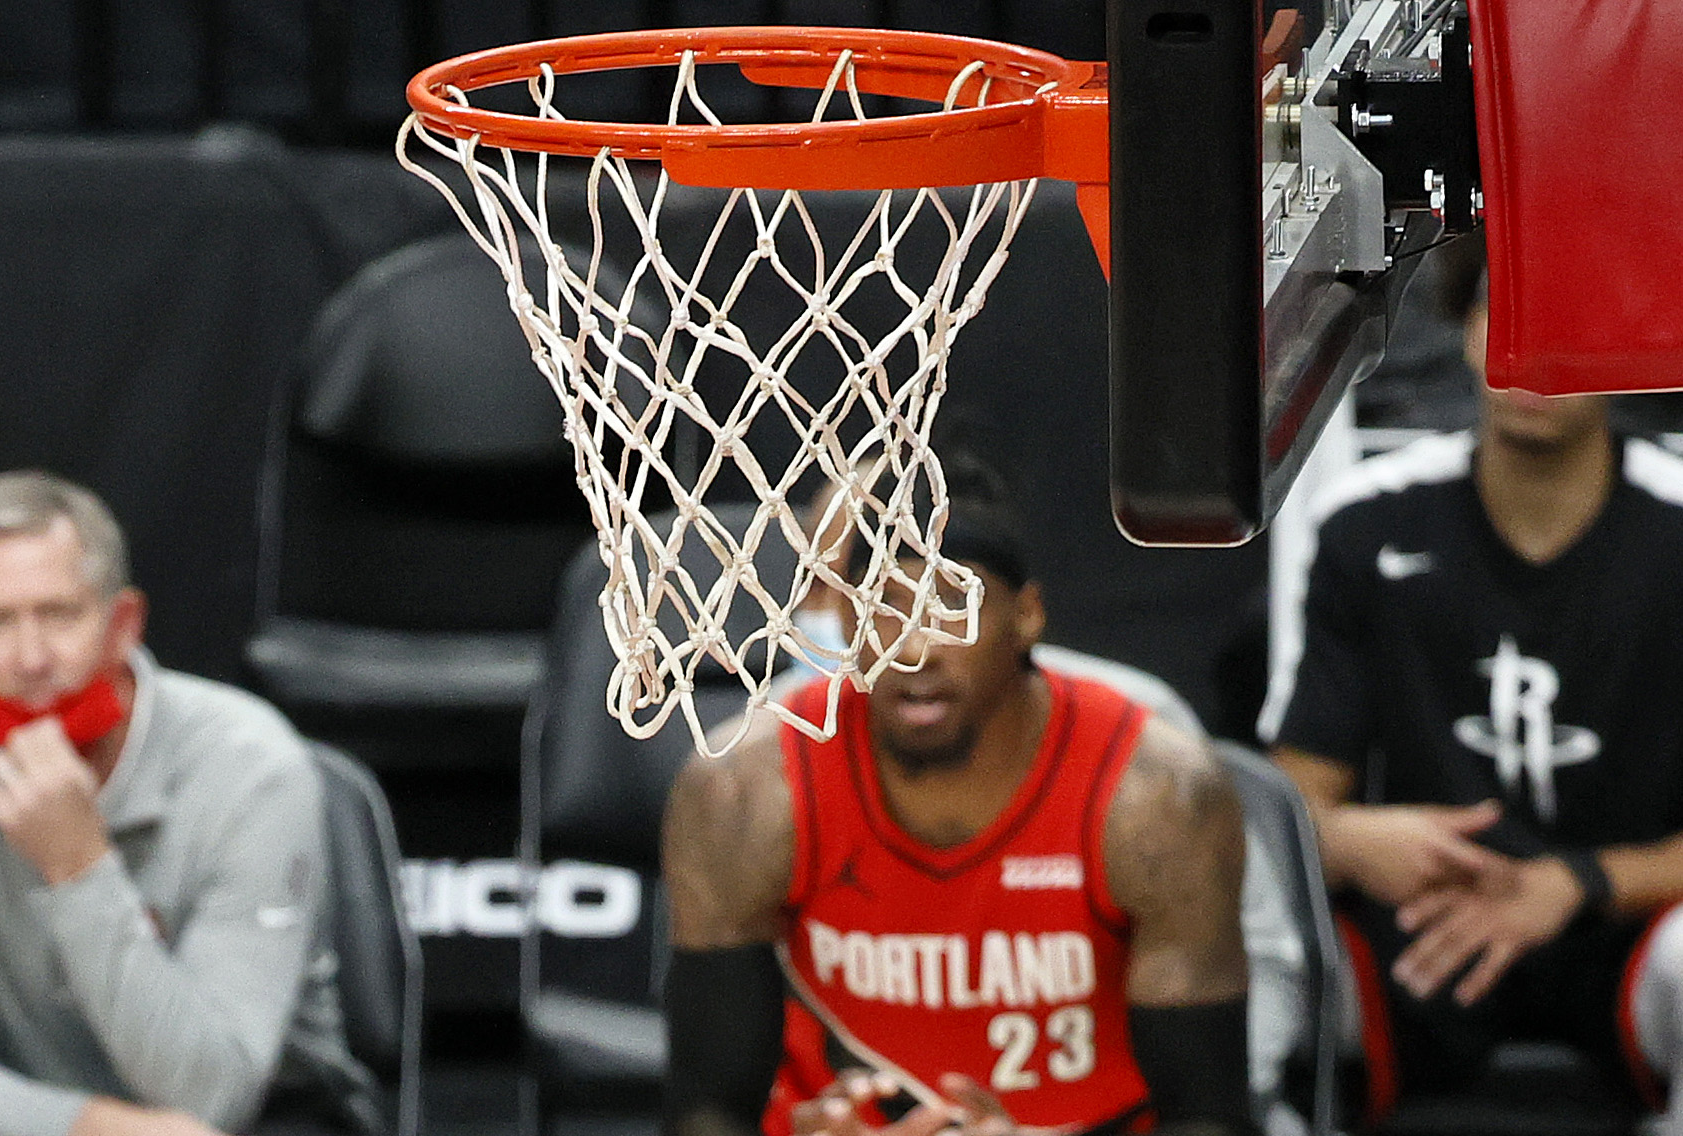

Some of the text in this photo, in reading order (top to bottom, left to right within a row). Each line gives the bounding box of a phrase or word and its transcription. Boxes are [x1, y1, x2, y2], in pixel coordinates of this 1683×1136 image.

[398, 859, 643, 938] ICO
[805, 918, 1096, 1009] PORTLAND
[986, 1003, 1097, 1092] 23
